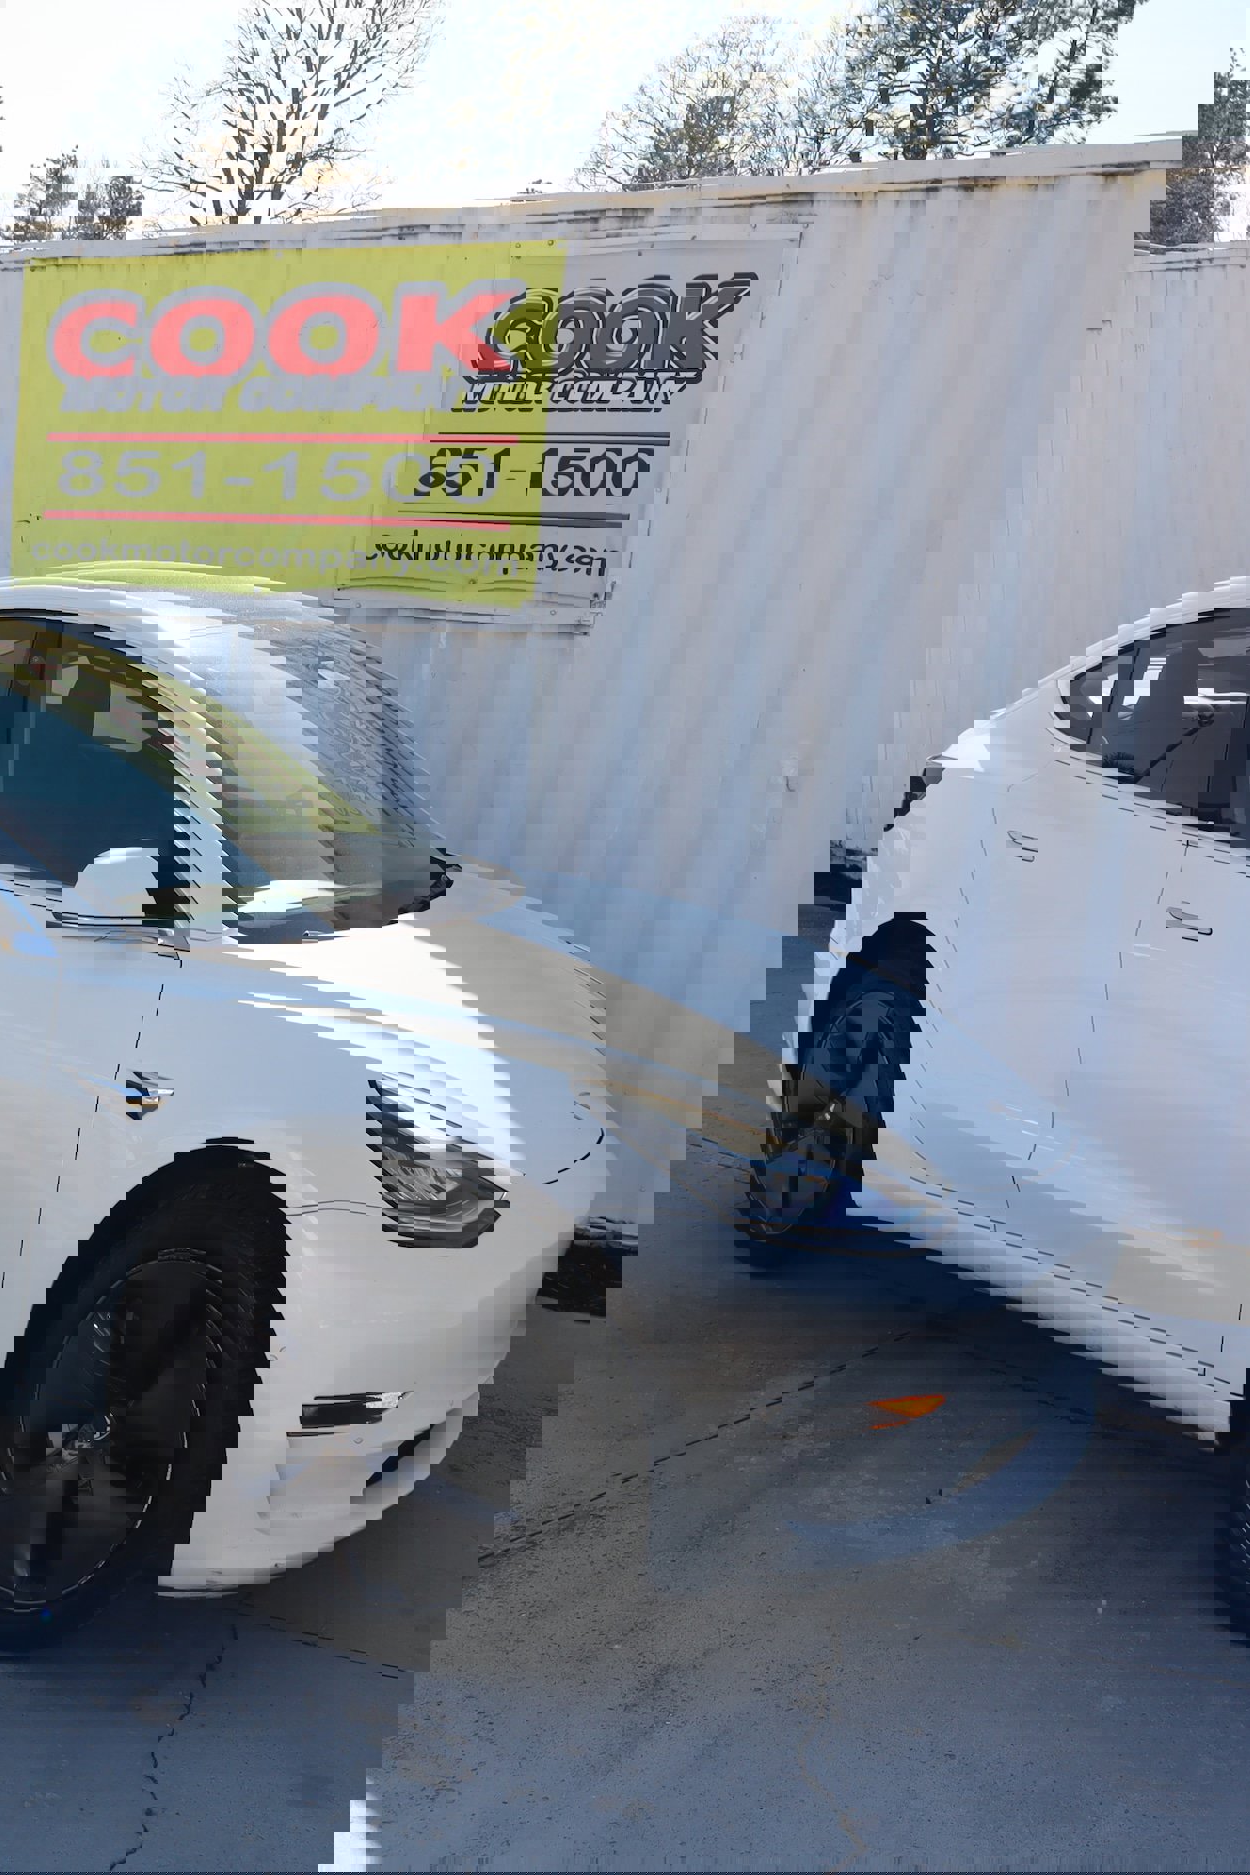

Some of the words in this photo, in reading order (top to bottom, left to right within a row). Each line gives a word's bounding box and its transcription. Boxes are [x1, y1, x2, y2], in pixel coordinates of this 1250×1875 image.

[48, 283, 524, 380] COOK
[56, 449, 499, 505] 851-1500
[31, 537, 519, 577] cookmotorcompany.com
